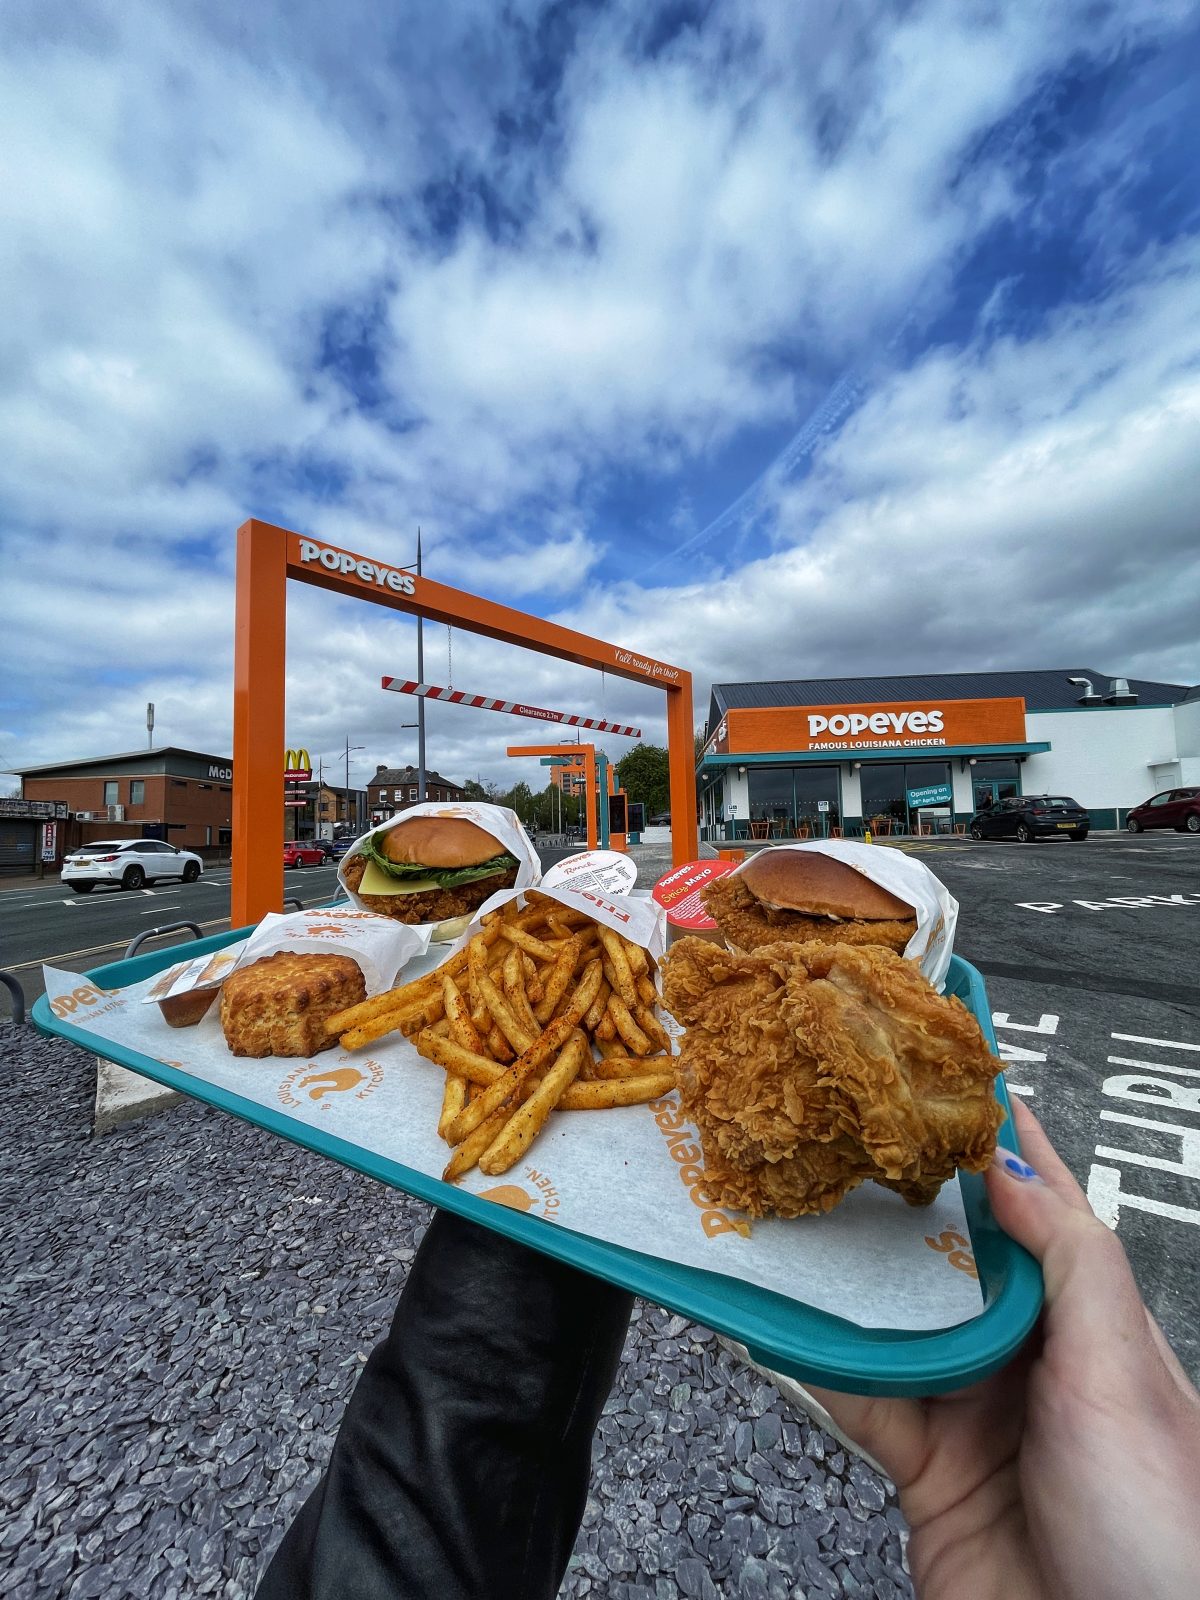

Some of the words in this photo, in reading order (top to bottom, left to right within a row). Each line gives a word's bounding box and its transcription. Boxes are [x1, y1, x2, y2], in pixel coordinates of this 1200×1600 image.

[632, 659, 652, 676] ready
[652, 663, 662, 676] for
[519, 706, 547, 718] Clearance
[546, 711, 559, 720] 2.7m
[808, 742, 848, 750] FAMOUS
[850, 740, 902, 749] LOUISIANA
[904, 738, 946, 747] CHICKEN
[910, 789, 938, 798] Opening
[563, 862, 597, 875] Ranch
[661, 886, 689, 903] Spicy
[684, 868, 712, 887] Mayo
[277, 1063, 318, 1108] LOUISIANA
[355, 1059, 384, 1099] KITCHEN
